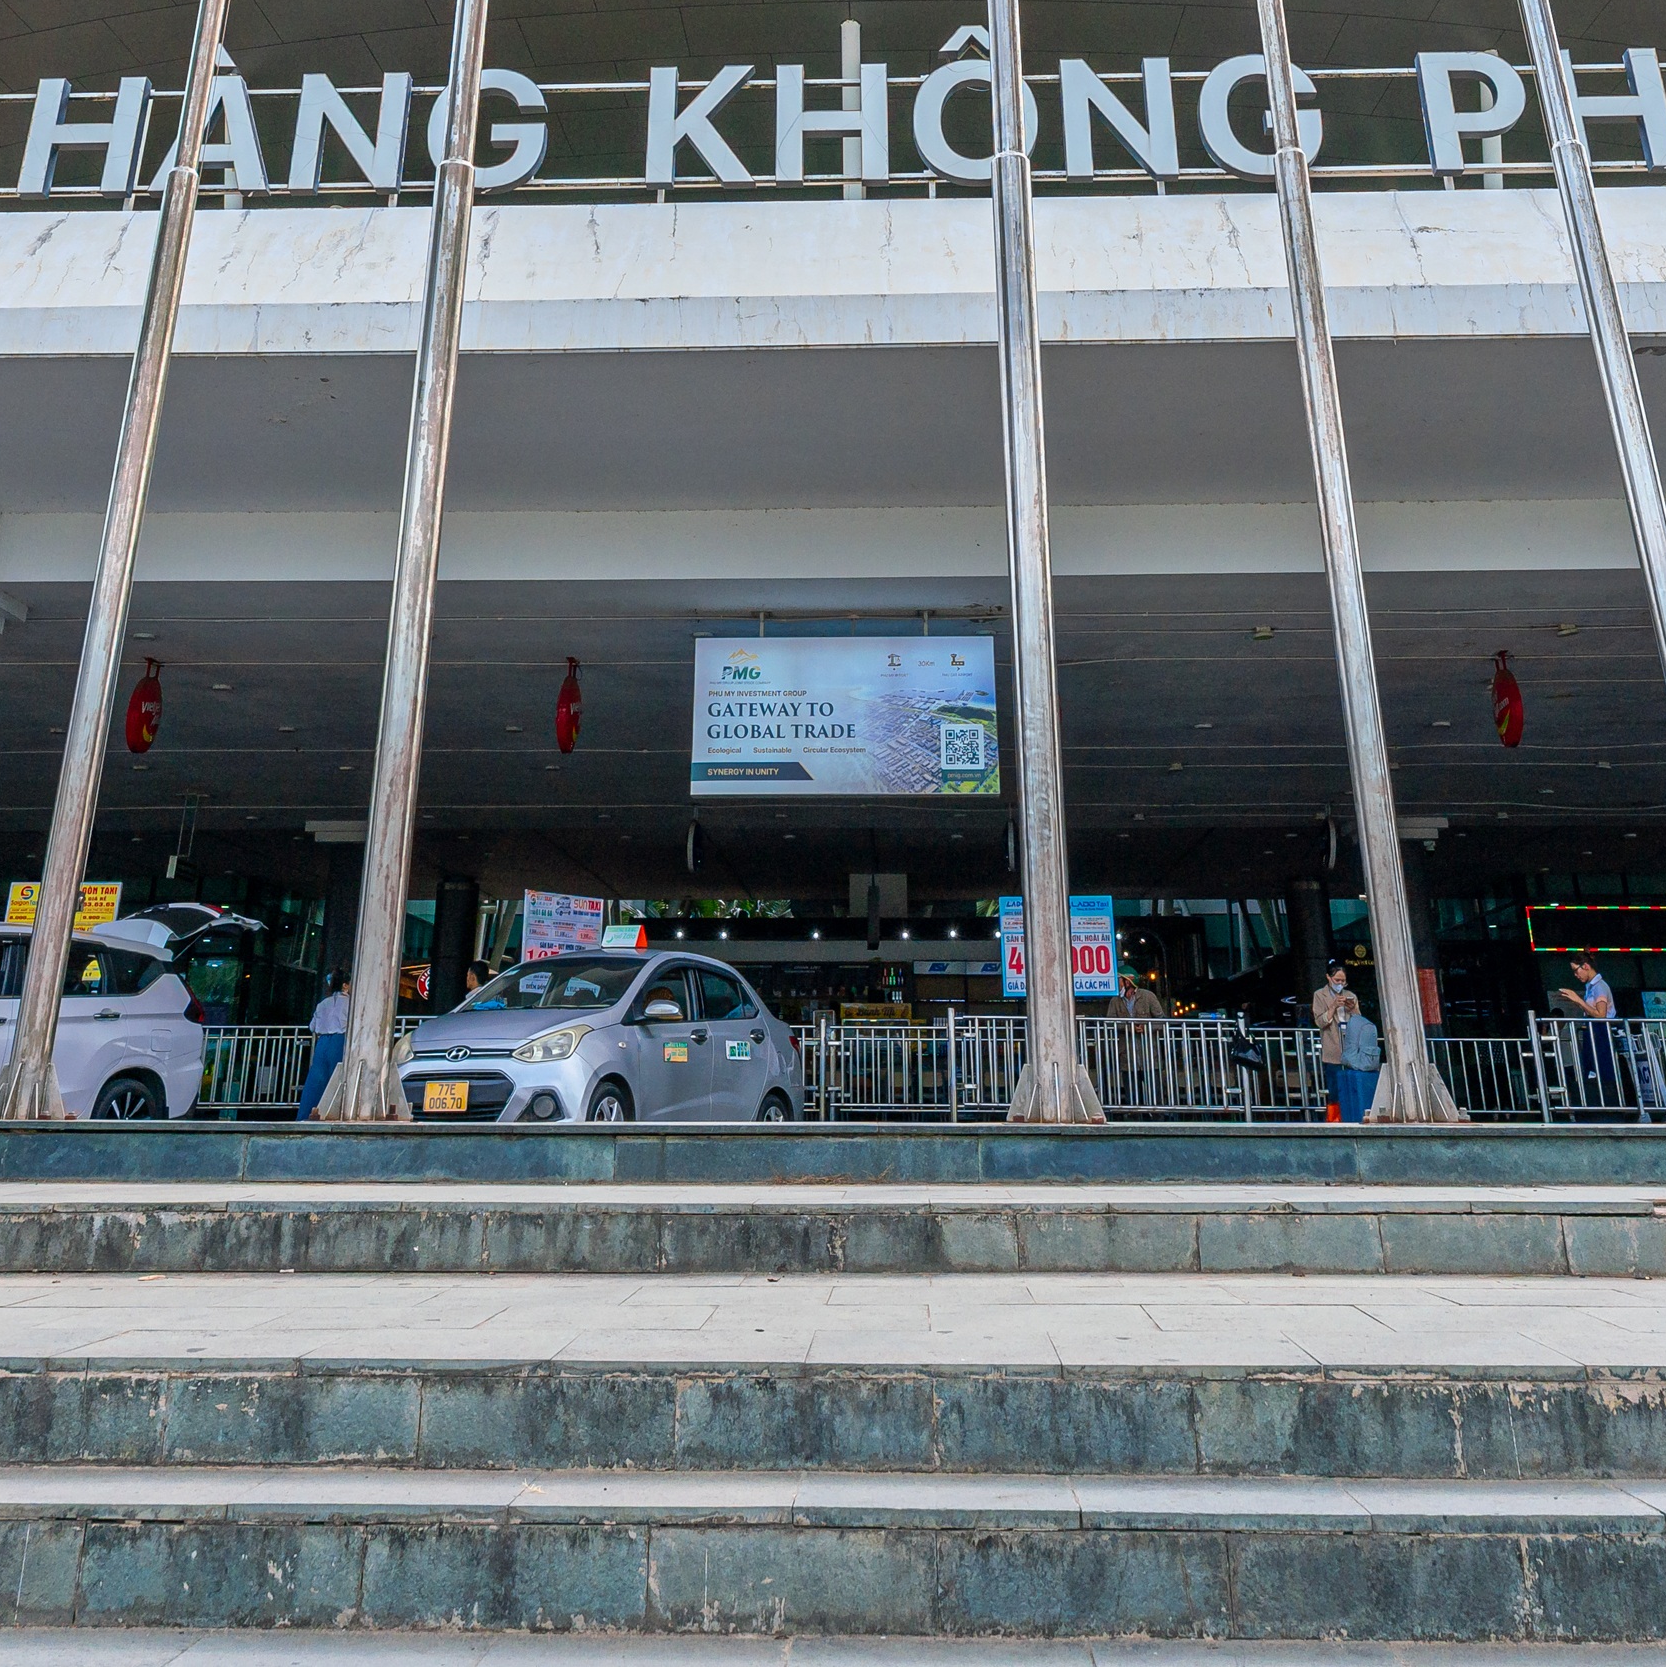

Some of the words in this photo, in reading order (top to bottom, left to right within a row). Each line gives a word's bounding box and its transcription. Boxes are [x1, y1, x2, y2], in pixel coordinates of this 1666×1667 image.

[17, 43, 548, 199] HÀNG
[645, 25, 1323, 190] KHÔNG
[721, 666, 761, 680] PMG
[707, 702, 802, 718] GATEWAY
[806, 702, 835, 717] TO
[707, 723, 786, 739] GLOBAL
[791, 723, 856, 739] TRADE
[707, 747, 742, 755] Ecological
[830, 747, 866, 755] Ecosystem
[707, 768, 744, 776] SYNERGY
[745, 768, 754, 776] IN
[755, 768, 779, 776] UNITY
[101, 886, 118, 895] TAXI
[1006, 934, 1017, 943] SÂN
[1084, 933, 1100, 942] HOÀI
[1007, 980, 1019, 991] GIÁ
[1084, 979, 1098, 990] CÁC
[438, 1083, 456, 1096] 77E
[429, 1097, 463, 1109] 006.70
